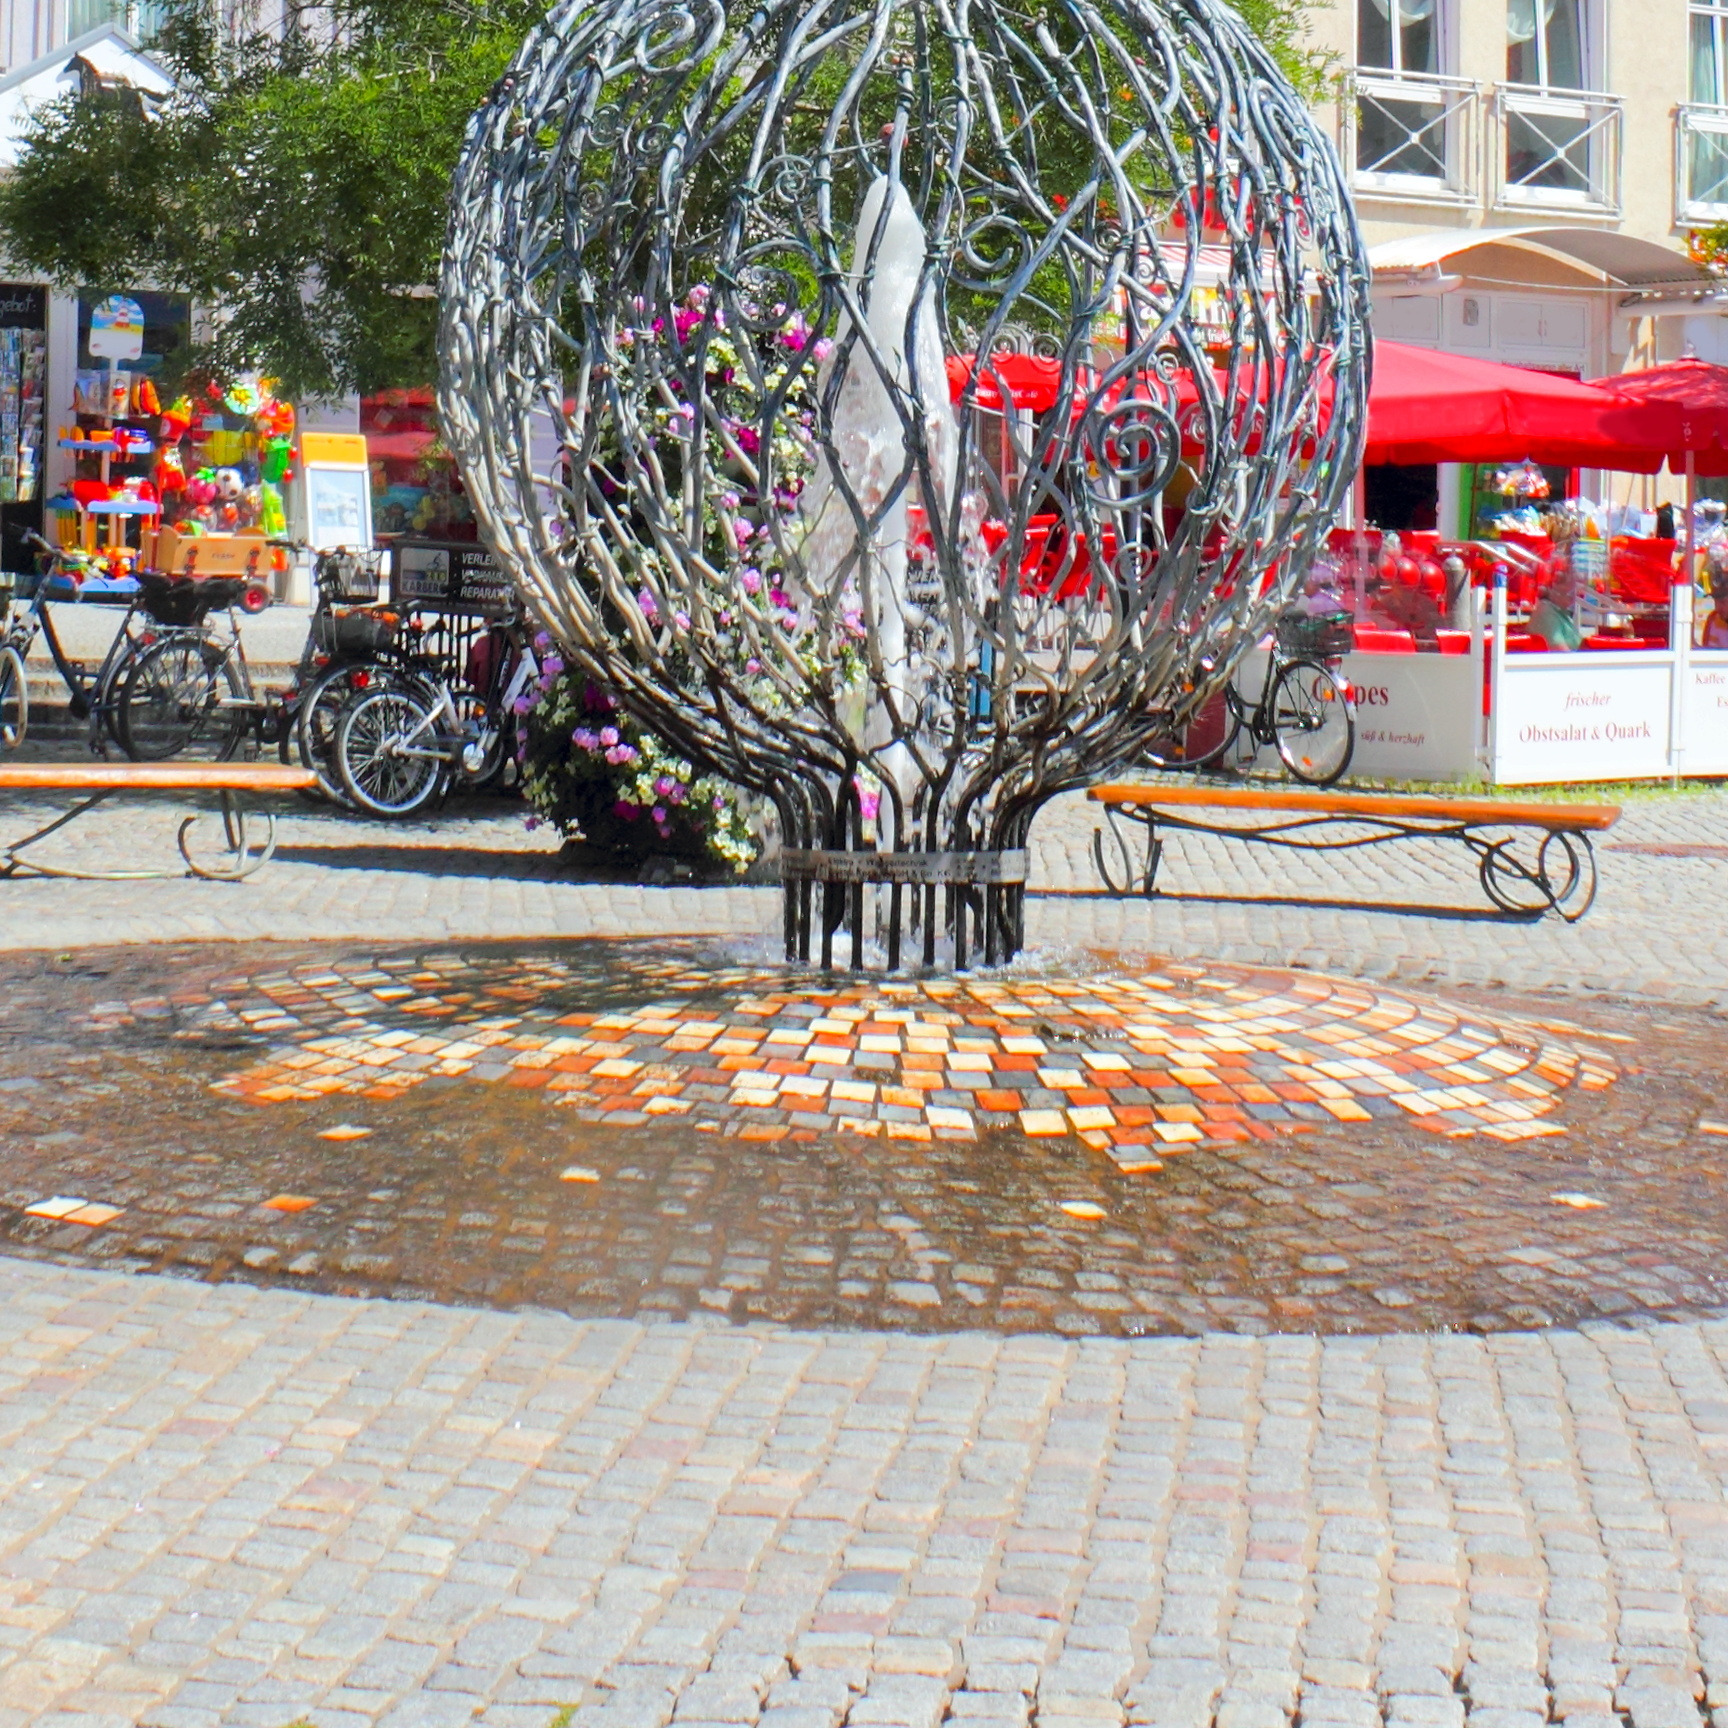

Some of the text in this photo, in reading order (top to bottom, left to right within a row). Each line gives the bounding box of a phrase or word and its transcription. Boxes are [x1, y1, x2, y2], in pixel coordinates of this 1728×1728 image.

[1695, 673, 1726, 685] Kaffee
[1564, 691, 1612, 712] frischer
[1519, 721, 1652, 743] Obstsalat & Quark
